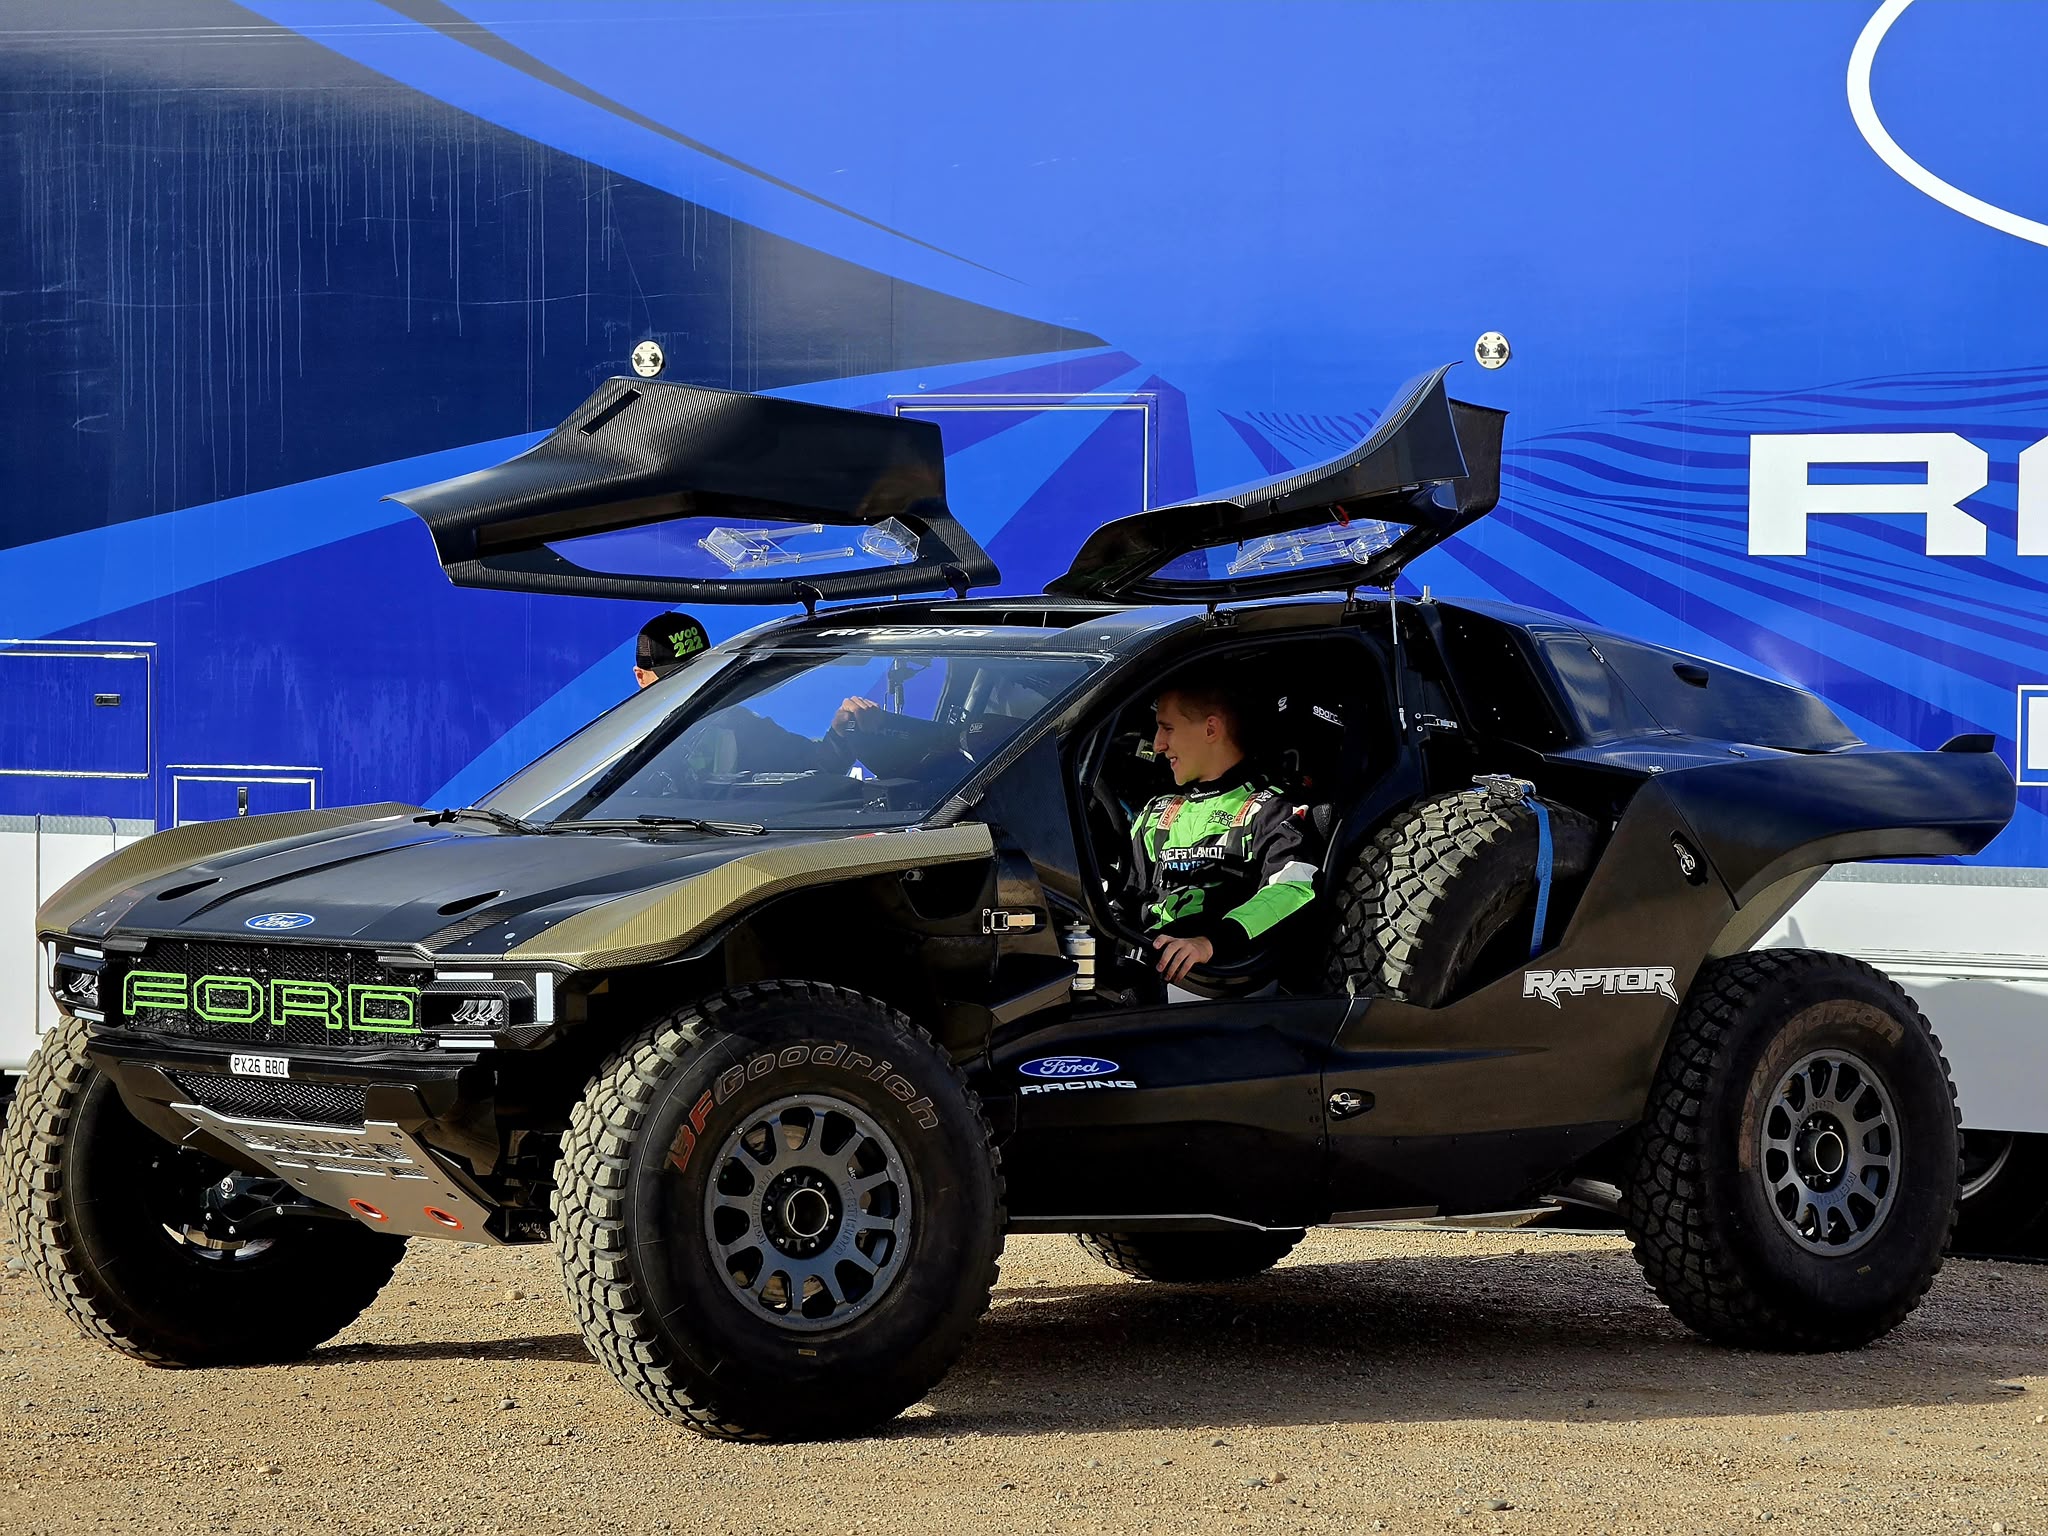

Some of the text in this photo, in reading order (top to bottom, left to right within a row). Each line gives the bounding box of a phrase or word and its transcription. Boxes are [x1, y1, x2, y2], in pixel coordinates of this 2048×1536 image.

[1747, 431, 2048, 556] R
[816, 627, 995, 638] RACING
[674, 635, 704, 658] 222
[1312, 705, 1341, 724] sparc
[254, 914, 304, 927] Ford
[1522, 965, 1679, 1009] RAPTOR
[123, 970, 421, 1034] FORD
[1039, 1057, 1101, 1075] Ford
[1020, 1080, 1137, 1096] RACING
